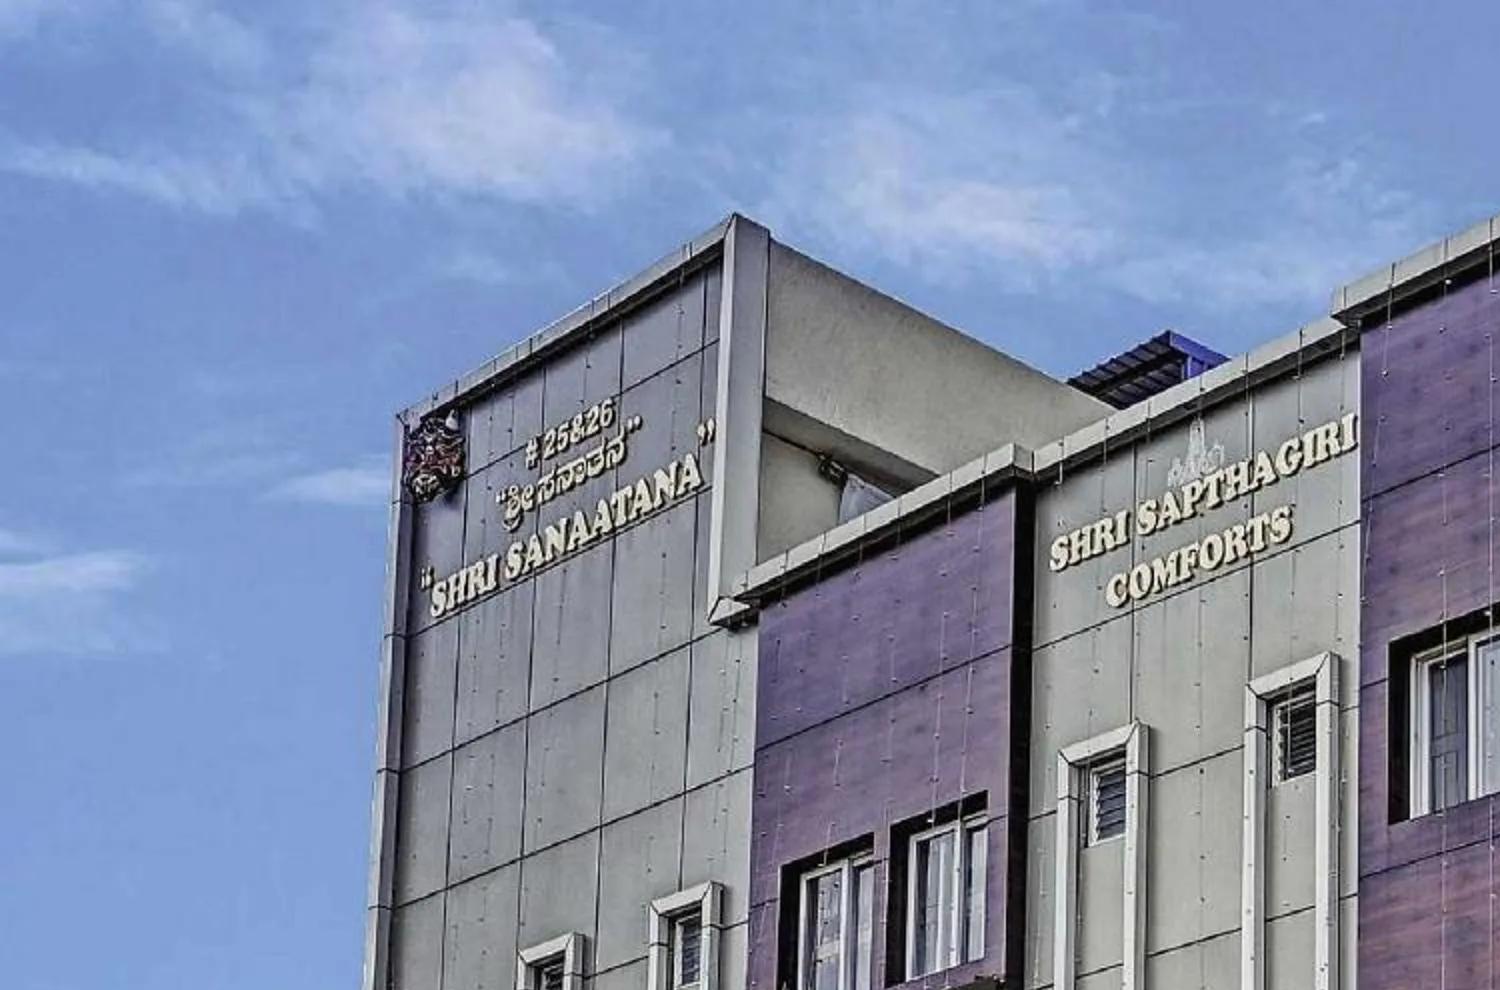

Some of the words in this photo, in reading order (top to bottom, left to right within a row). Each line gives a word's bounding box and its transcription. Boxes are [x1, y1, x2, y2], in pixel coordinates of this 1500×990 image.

[1049, 509, 1131, 572] SHRI
[1135, 412, 1359, 536] SAPTHAGIRI
[1105, 505, 1295, 608] COMFORTS
